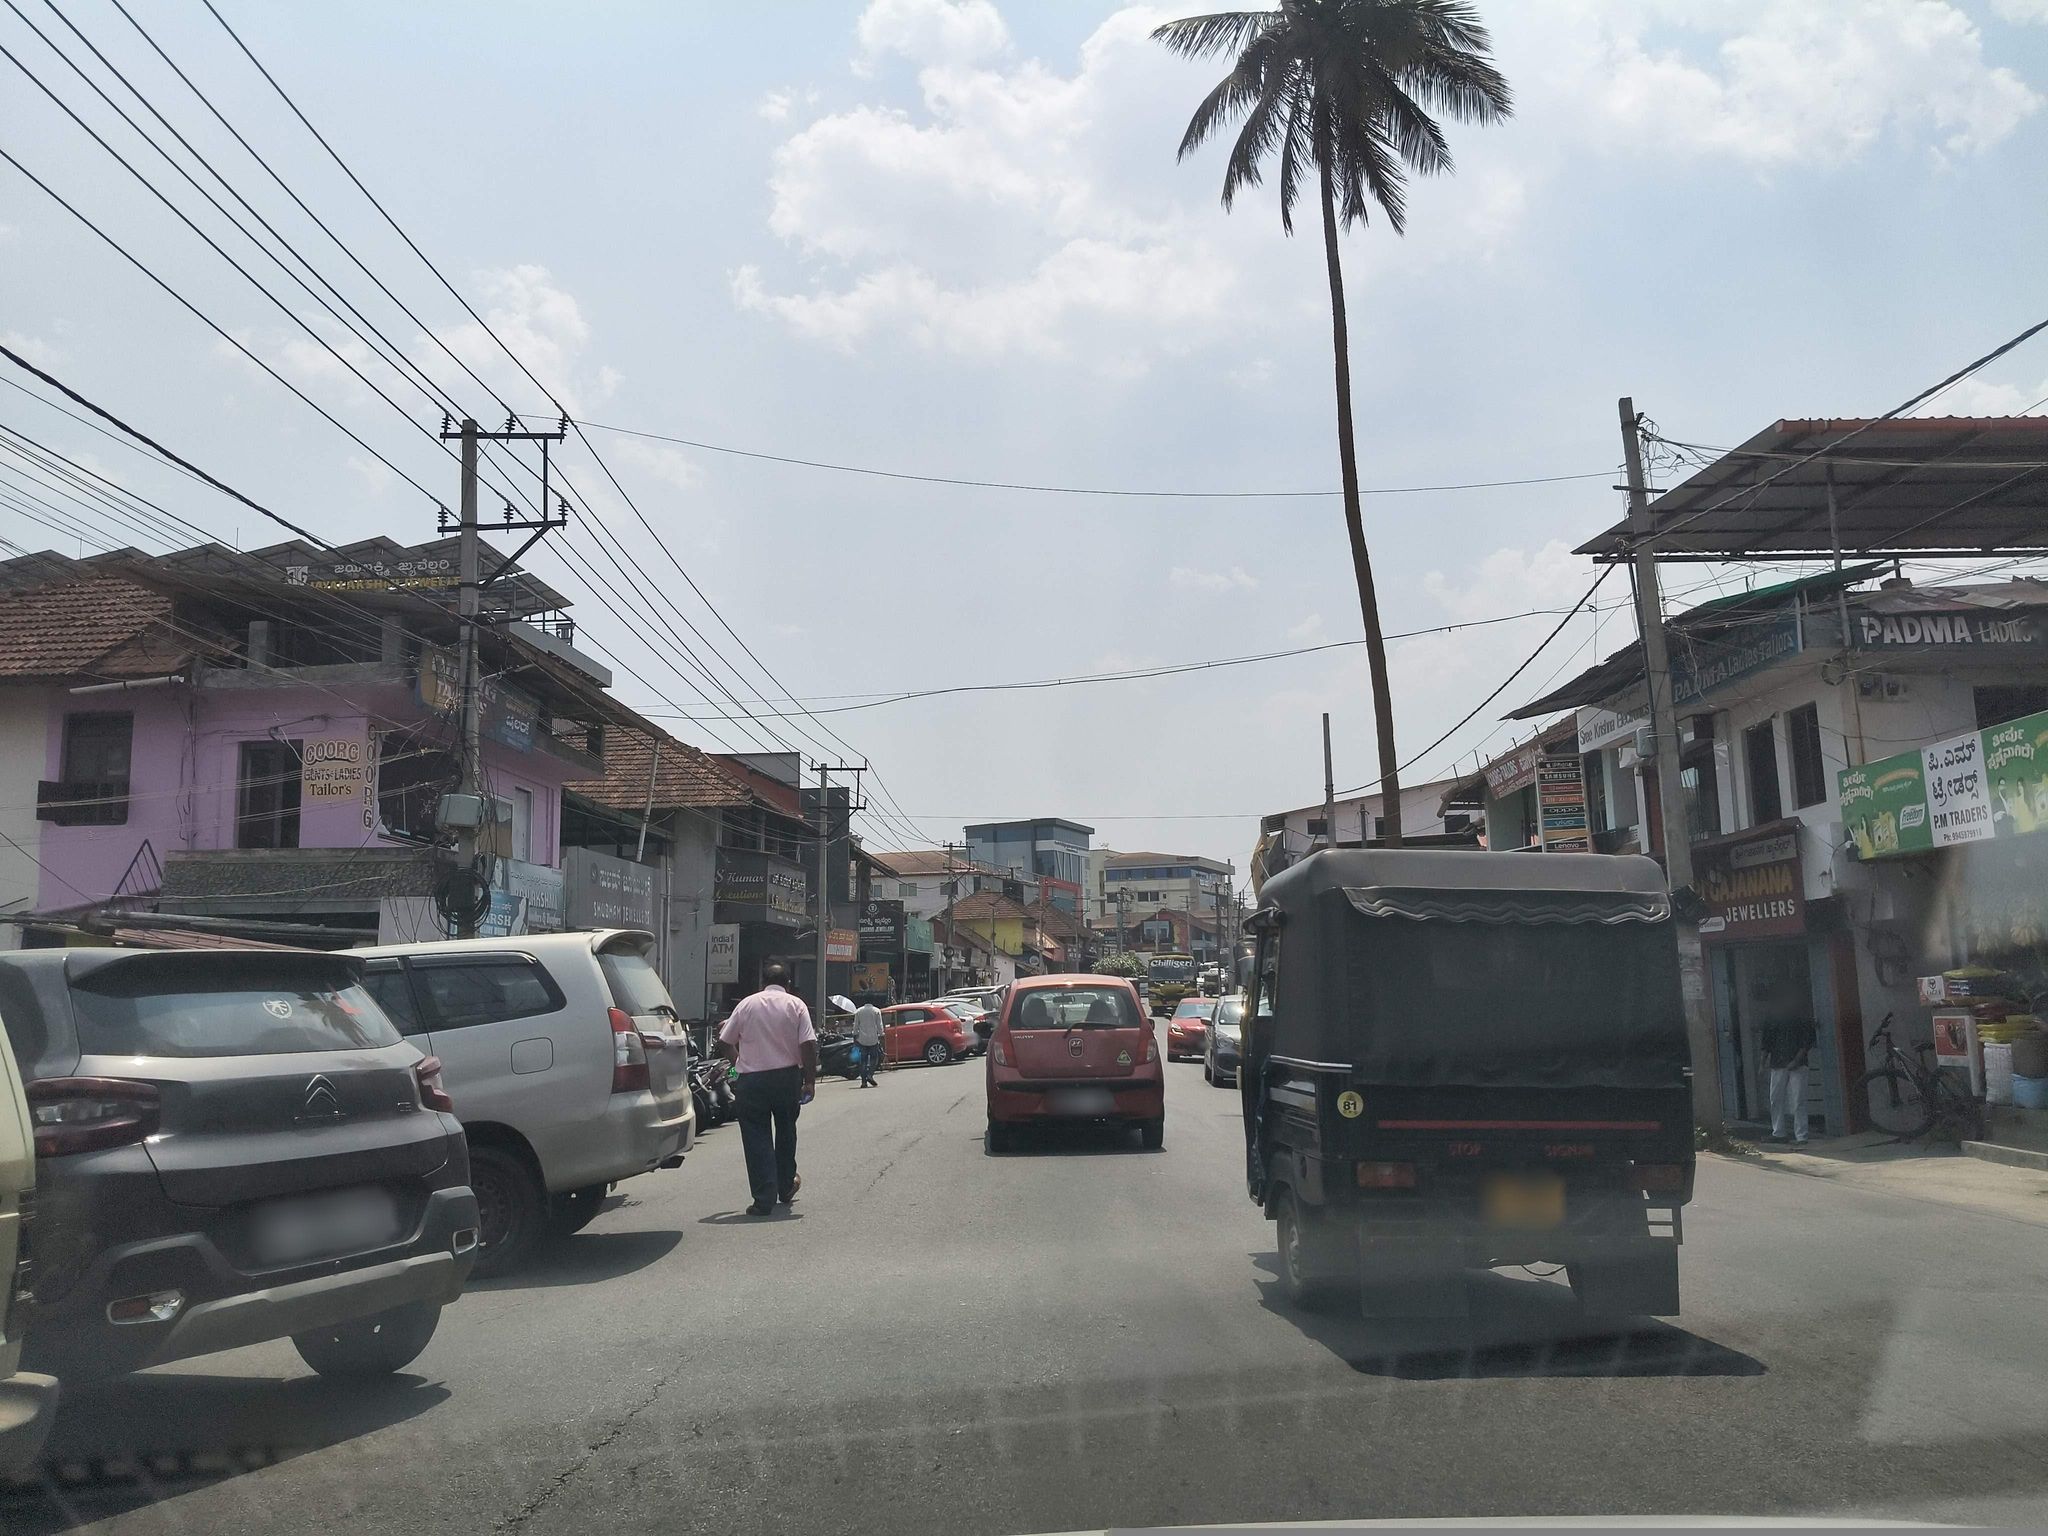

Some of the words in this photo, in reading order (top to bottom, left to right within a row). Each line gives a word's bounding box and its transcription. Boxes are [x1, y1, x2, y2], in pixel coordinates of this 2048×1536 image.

[1860, 616, 1973, 644] PADMA
[1673, 661, 1728, 703] PADMA
[1580, 729, 1593, 746] Sree
[1594, 719, 1616, 740] Krishna
[1616, 703, 1650, 729] Electronics
[305, 741, 360, 764] COORG
[310, 783, 352, 796] Tailor's
[1933, 812, 1948, 830] P.M
[1949, 804, 1988, 827] TRADERS
[728, 872, 764, 883] Kumar
[1725, 899, 1795, 923] JEWELLERS
[711, 944, 734, 954] ATM
[1343, 1100, 1357, 1111] 81
